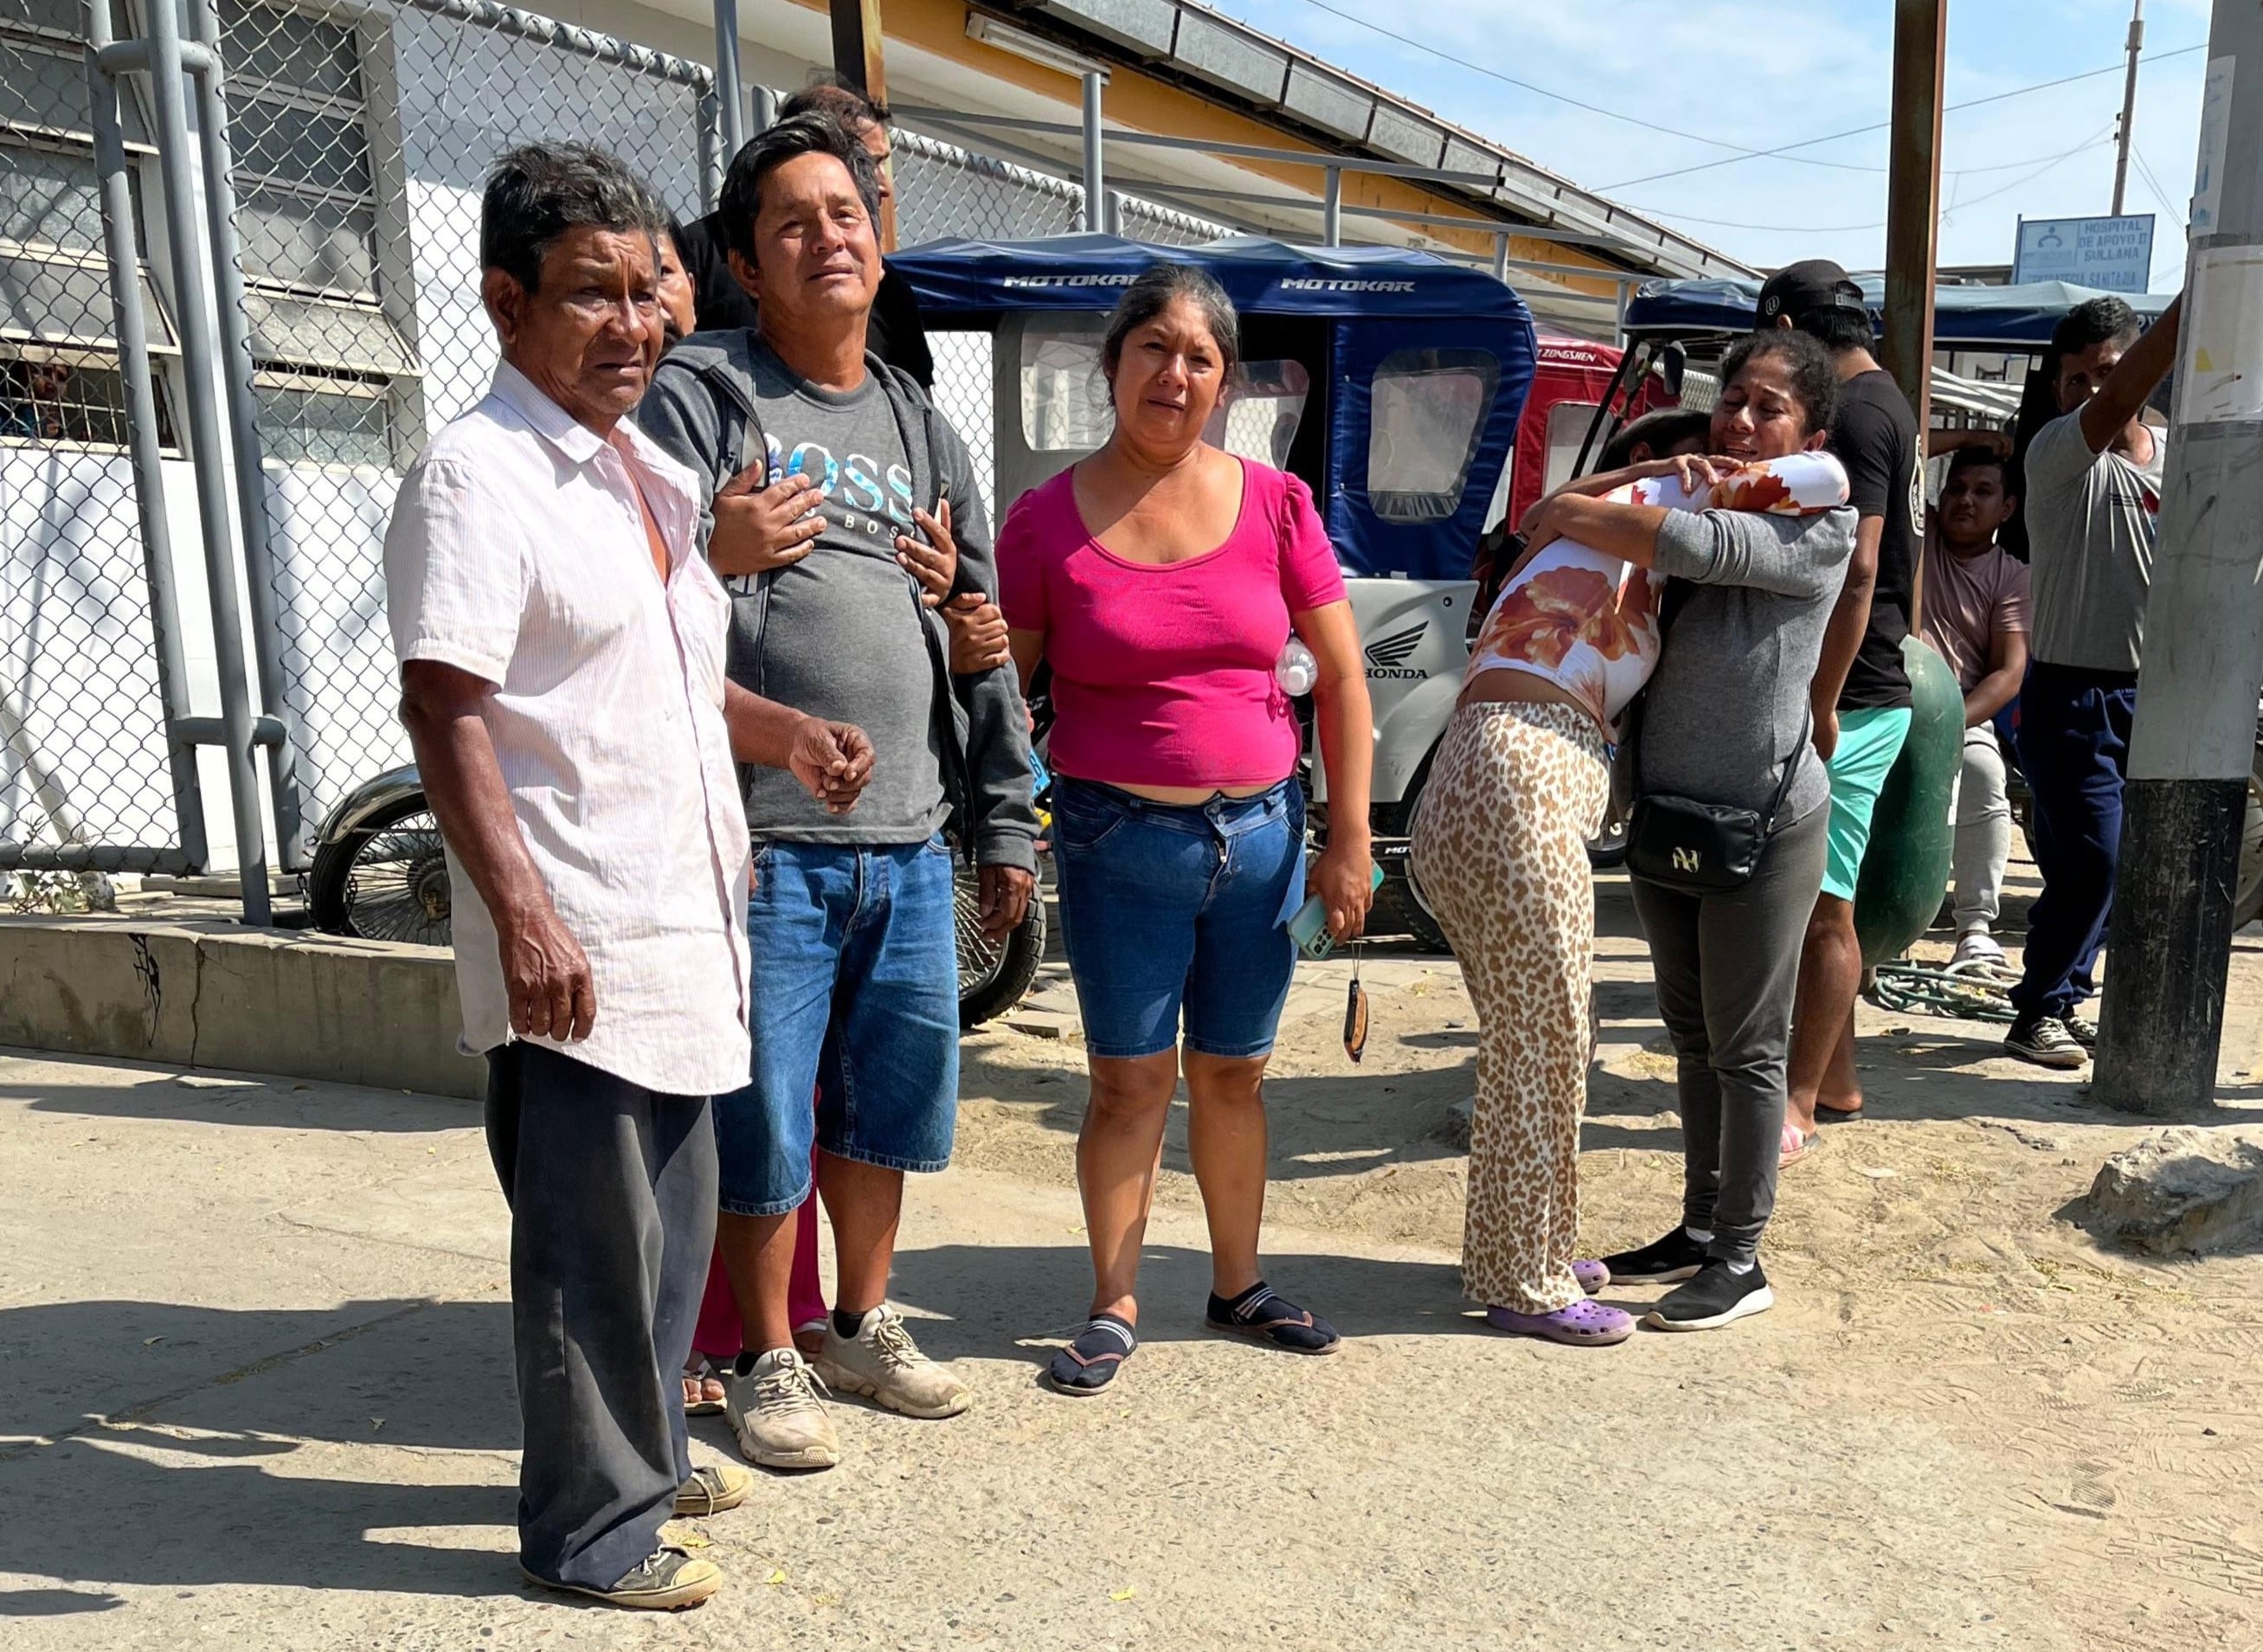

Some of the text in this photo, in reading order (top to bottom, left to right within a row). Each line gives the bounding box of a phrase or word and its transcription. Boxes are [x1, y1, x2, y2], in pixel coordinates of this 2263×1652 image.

[2085, 220, 2143, 234] HOSPITAL
[2079, 236, 2094, 248] DE
[2097, 234, 2135, 247] APOYO
[2085, 247, 2139, 261] SULLANA
[1281, 278, 1416, 292] MOTOKAR
[1541, 349, 1597, 362] ZONGSHEN
[1365, 668, 1428, 679] HONDA
